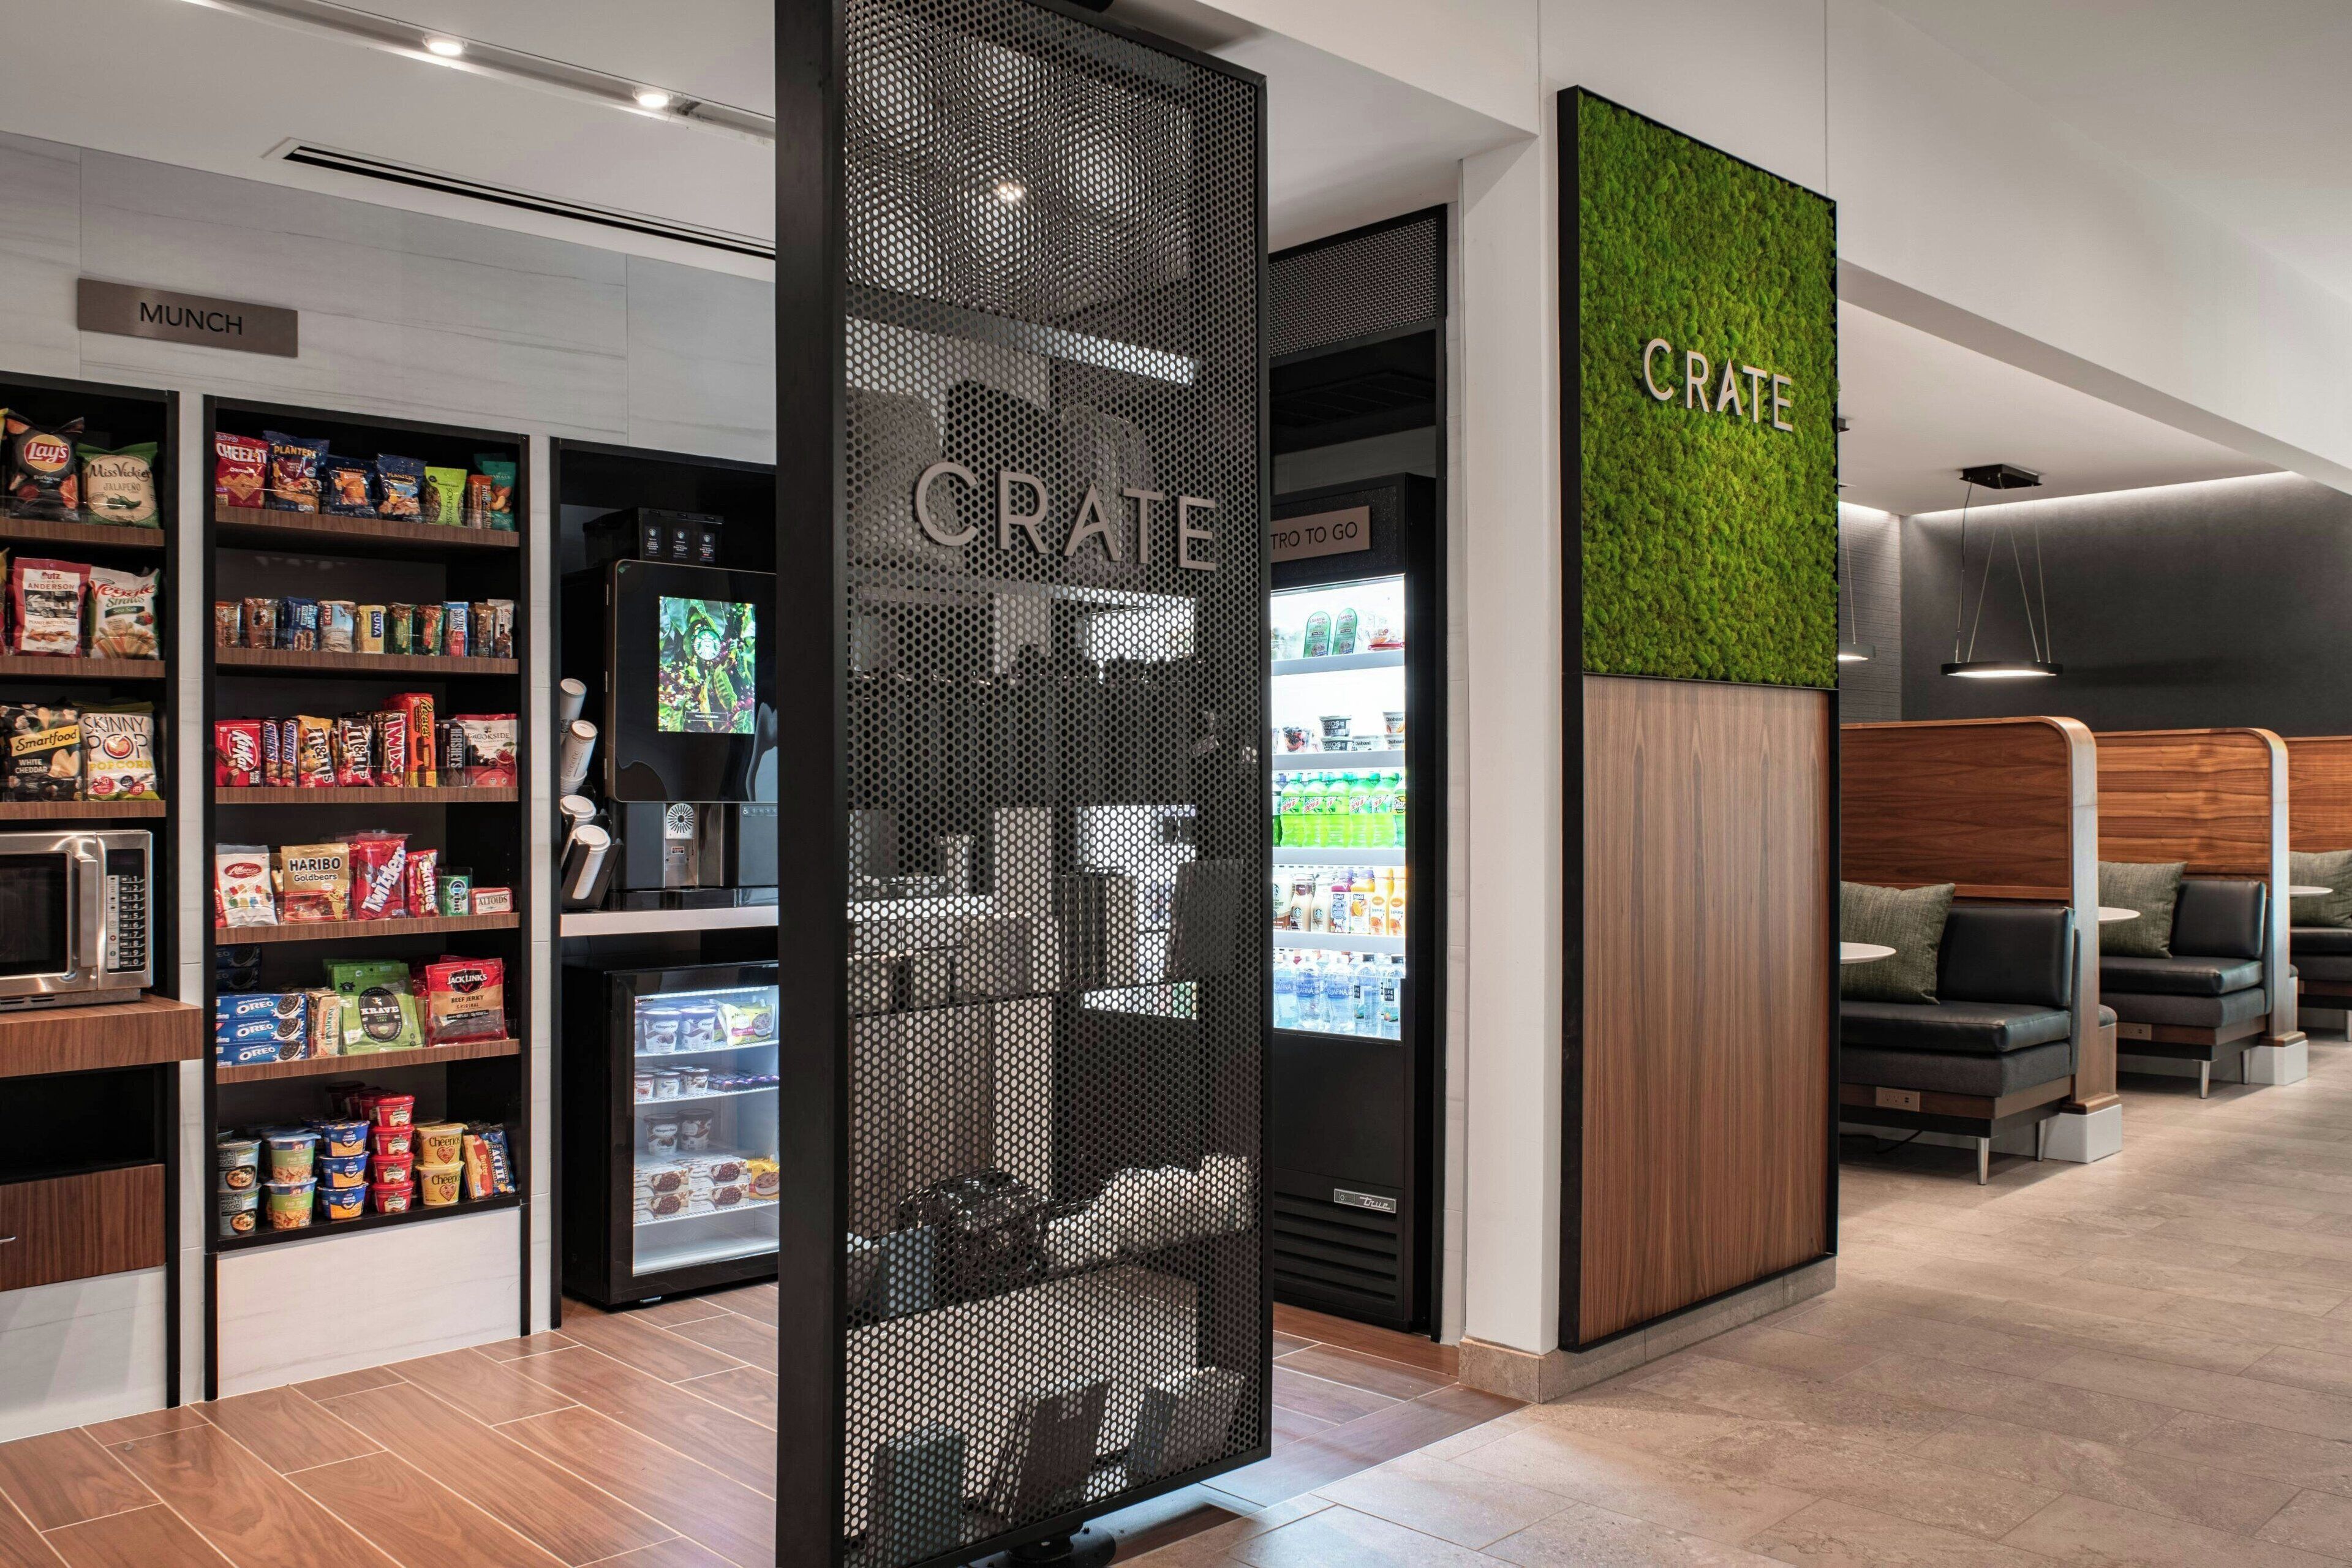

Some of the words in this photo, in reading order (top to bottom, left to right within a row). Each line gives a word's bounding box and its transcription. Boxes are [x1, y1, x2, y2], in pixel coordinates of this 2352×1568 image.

[140, 302, 243, 335] MUNCH
[1643, 337, 1793, 432] CRATE
[28, 442, 68, 464] Lay's
[274, 445, 317, 459] PLANTERS
[88, 464, 117, 478] Miss
[387, 472, 416, 481] PLANTERS
[104, 481, 141, 491] JALAPEÑO
[915, 461, 1216, 571] CRATE
[1305, 526, 1327, 545] TO
[1332, 521, 1358, 540] GO
[89, 580, 157, 599] Veggie
[107, 596, 145, 608] Straws
[373, 612, 382, 636] LUNA
[420, 698, 433, 739] Reese's
[16, 729, 78, 752] Smartfood
[86, 733, 148, 762] POP
[264, 723, 277, 762] SNICKERS
[284, 723, 296, 763] SNICKERS
[385, 714, 405, 772] TWIX
[450, 728, 463, 768] HERSHEY'S
[15, 766, 48, 774] CHEDDAR
[89, 760, 152, 771] POPCORN
[289, 857, 341, 872] HARIBO
[294, 873, 337, 882] Goldbears
[419, 861, 436, 911] Skittles
[478, 895, 508, 906] ALTOIDS
[447, 976, 465, 986] JACK
[236, 1001, 274, 1015] OREO
[360, 1006, 399, 1016] KRAVE
[236, 1023, 274, 1038] OREO
[239, 1047, 276, 1061] OREO
[480, 1154, 488, 1176] Butter
[492, 1149, 503, 1169] ACT
[1359, 1196, 1390, 1210] true
